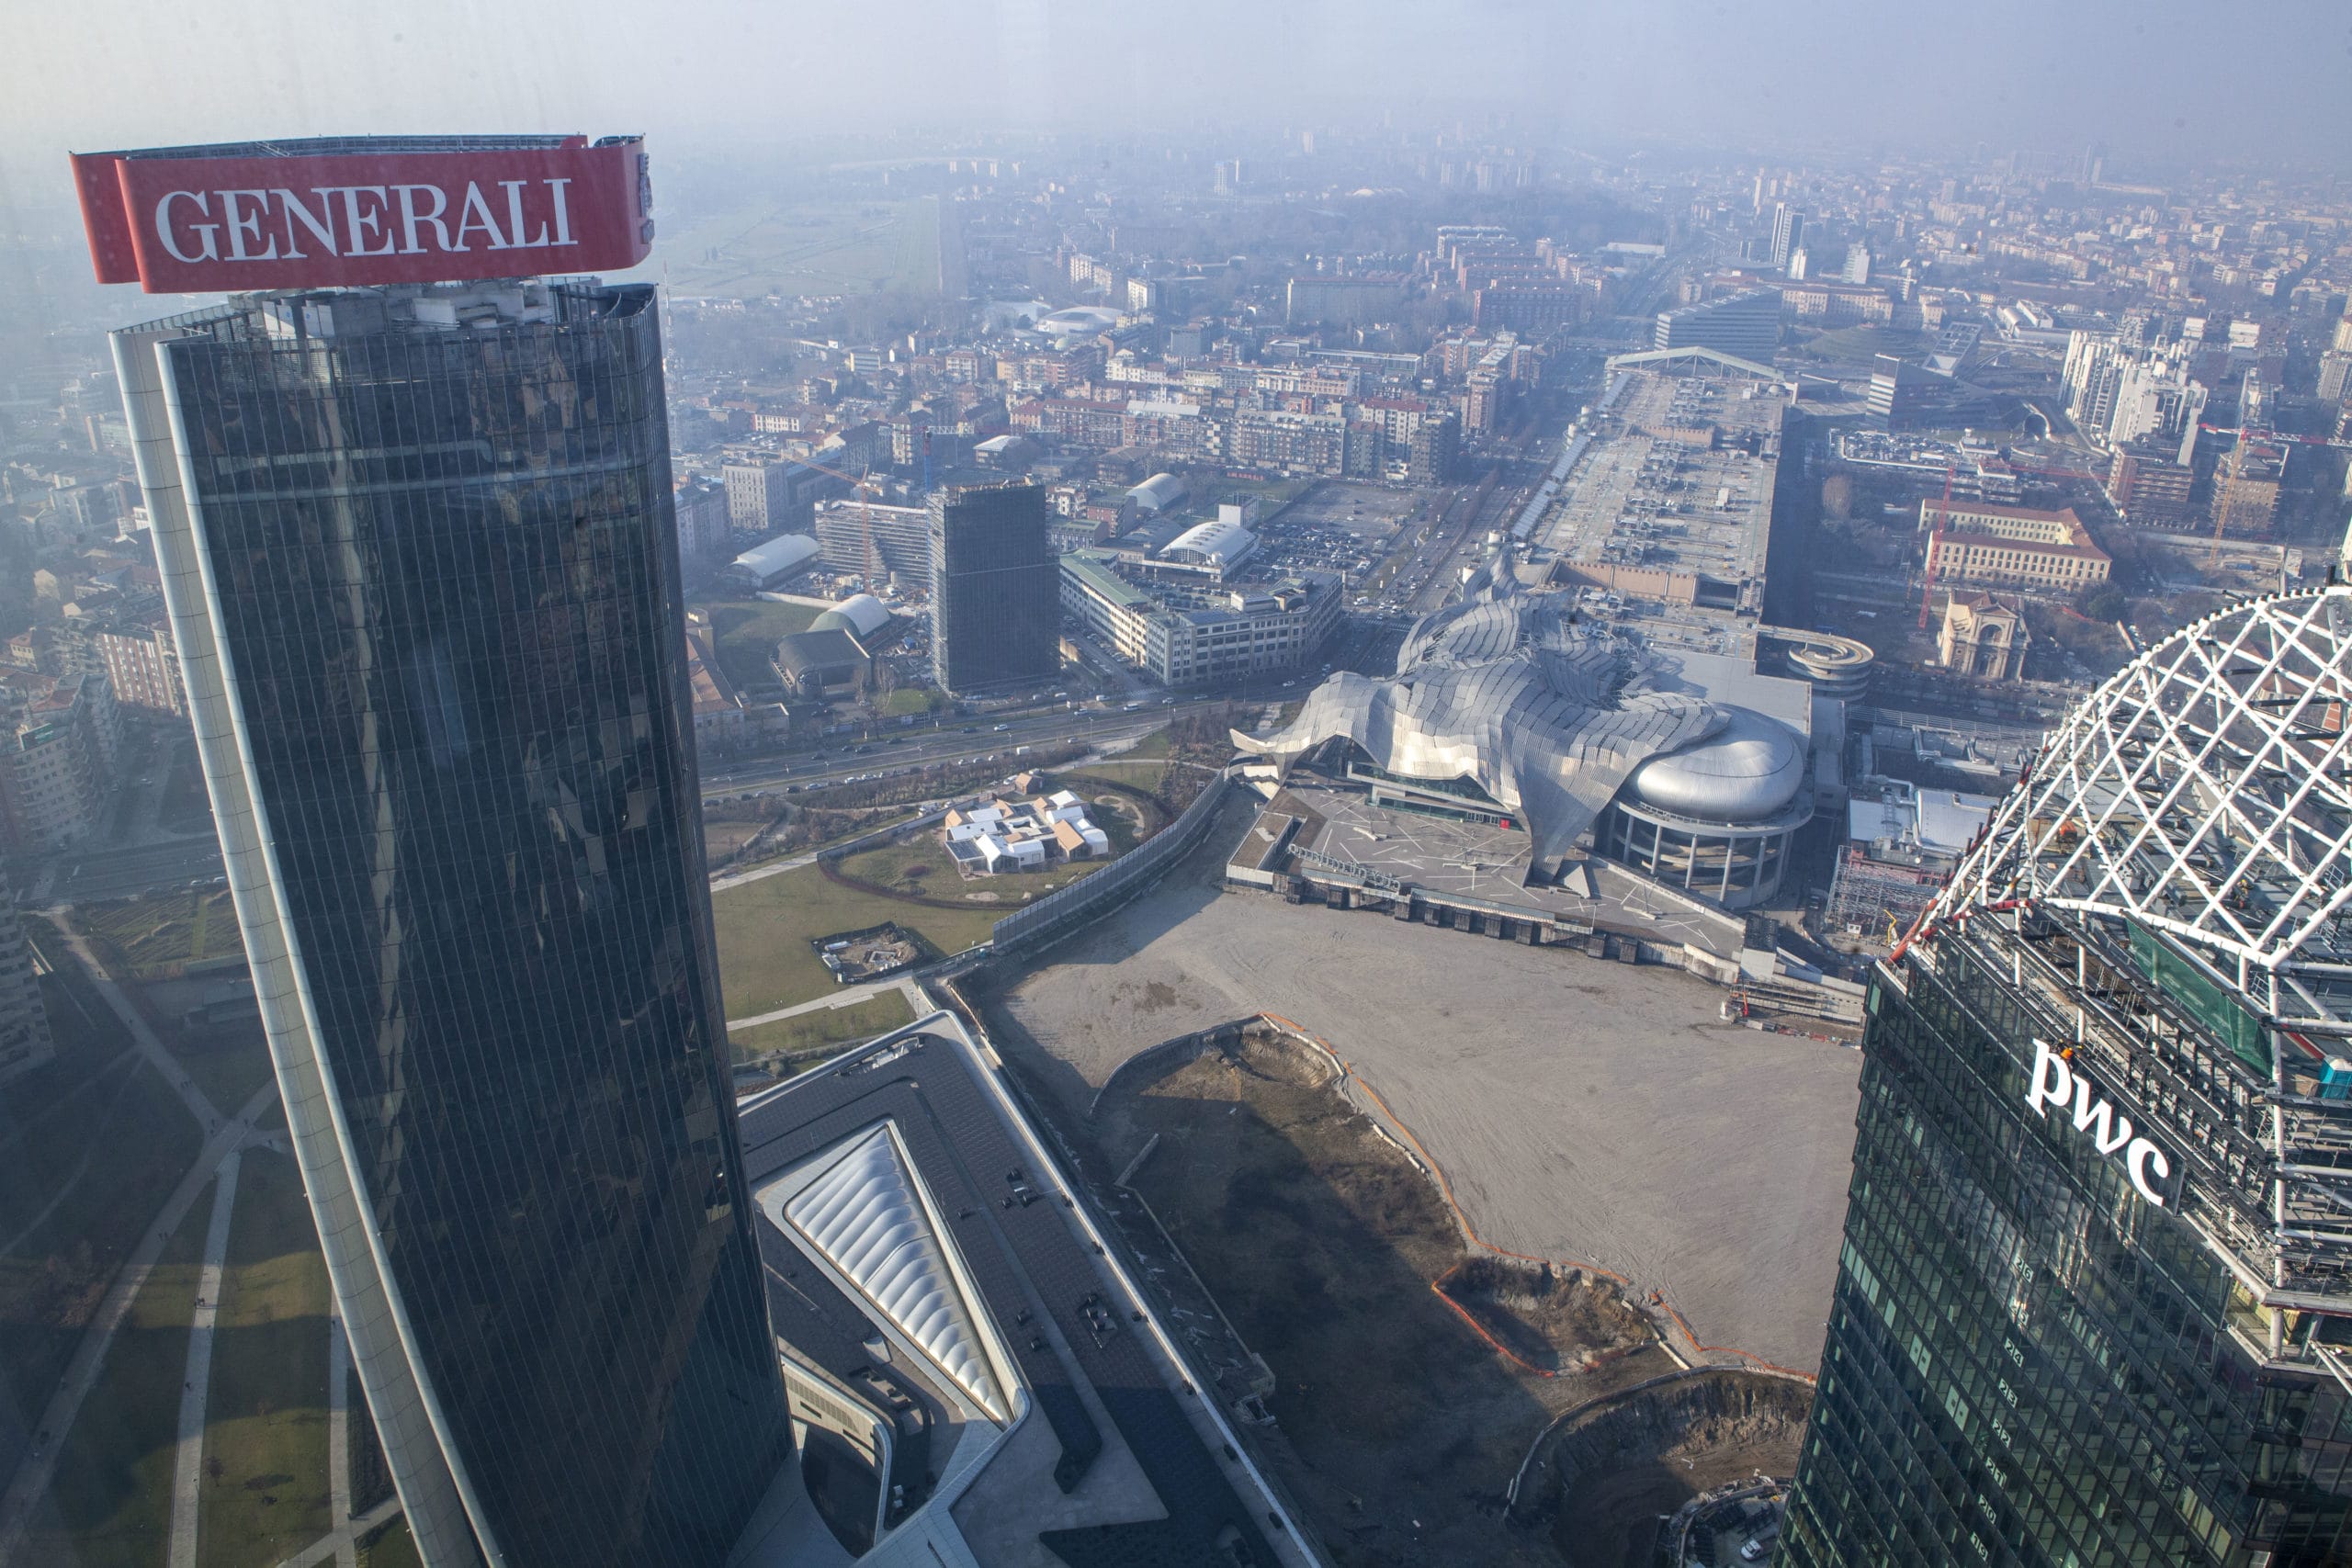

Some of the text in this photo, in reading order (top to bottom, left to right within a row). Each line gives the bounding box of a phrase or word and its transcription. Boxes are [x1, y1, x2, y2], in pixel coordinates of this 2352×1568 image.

[155, 178, 578, 264] GENERALI
[2024, 1038, 2169, 1207] pwc
[2006, 1339, 2022, 1365] 24
[2000, 1380, 2016, 1405] 23
[1994, 1419, 2009, 1446] 22
[1986, 1459, 2003, 1484] 21
[1980, 1495, 1995, 1521] 20
